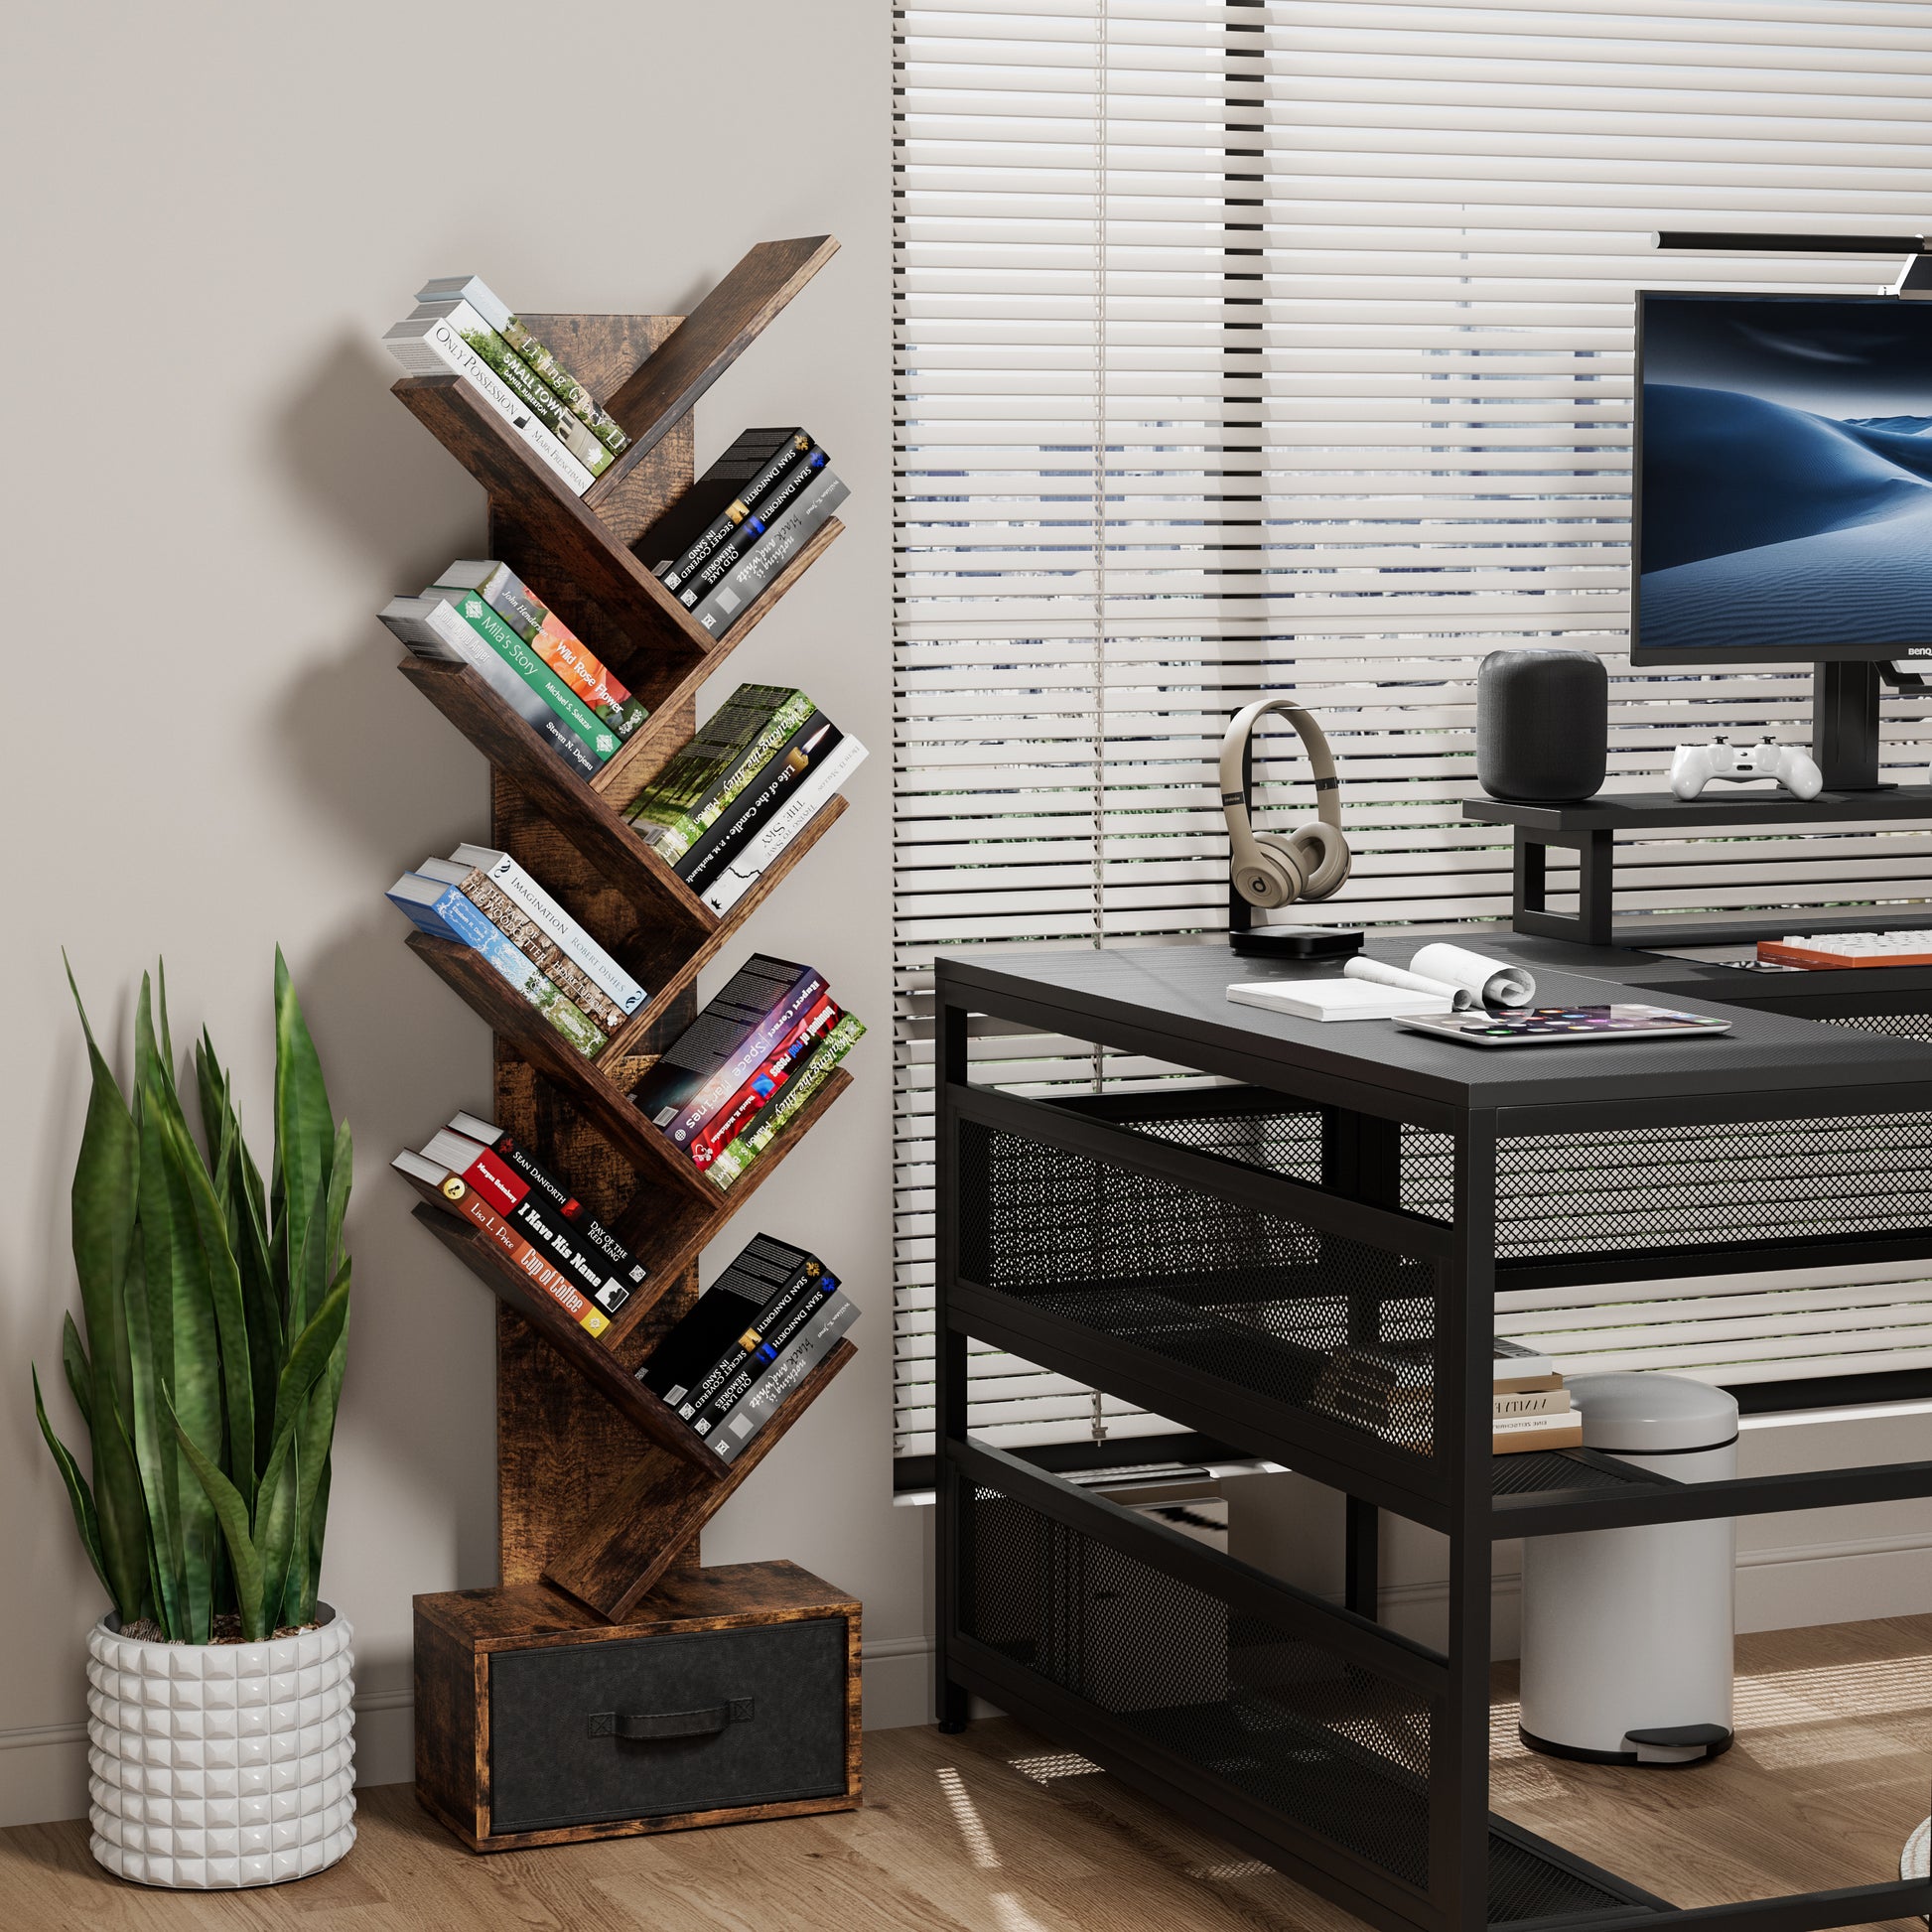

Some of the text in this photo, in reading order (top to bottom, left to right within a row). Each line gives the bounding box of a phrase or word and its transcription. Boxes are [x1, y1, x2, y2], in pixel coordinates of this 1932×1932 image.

[433, 325, 469, 361] ONLY
[462, 355, 521, 415] POSSESSION
[500, 351, 567, 420] SMALL TOWN
[502, 369, 523, 389] DANIEL
[518, 337, 609, 429] Living Glory
[531, 430, 554, 453] MARK
[743, 449, 796, 505] SEAN DANFORTH
[759, 465, 812, 522] SEAN DANFORTH
[679, 520, 734, 579] SECRET COVERED
[686, 529, 716, 560] IN SAND
[699, 542, 735, 580] MEMORIES
[706, 549, 740, 585] OLD LAKE
[734, 513, 803, 586] black and white
[755, 531, 796, 580] nothing is
[500, 588, 550, 638] John Henderson
[467, 639, 492, 665] Anger
[481, 616, 540, 678] Mila's Story
[1908, 647, 1932, 656] BenQ
[554, 641, 625, 716] Wild Rose Flower
[544, 681, 593, 731] Michael S. Salazar
[545, 721, 568, 744] Steven
[564, 740, 575, 752] N.
[719, 709, 799, 795] Walking the Alley
[728, 763, 795, 837] Life of the Candle
[759, 797, 805, 851] THE SKY
[662, 832, 688, 860] Bwn
[684, 852, 714, 884] Burkhardt
[466, 882, 548, 964] THE WOODCUTTER
[485, 887, 505, 906] THE
[523, 924, 539, 940] OF
[509, 876, 569, 935] IMAGINATION
[552, 960, 579, 987] HENRY
[570, 936, 600, 966] ROBERT
[765, 978, 820, 1038] Rupert Cornet
[729, 1038, 766, 1078] Space
[786, 1039, 805, 1058] red
[798, 1032, 812, 1045] of
[767, 1052, 791, 1077] roses
[770, 1033, 848, 1118] Walking the Alley
[511, 1151, 567, 1204] SEAN DANFORTH
[715, 1154, 741, 1182] Bwn
[470, 1202, 518, 1250] Lisa L. Price
[516, 1202, 605, 1288] I Have His Name
[587, 1229, 621, 1262] RED KING
[589, 1221, 628, 1259] DAY OF THE
[516, 1247, 587, 1313] Cup of Coffee
[756, 1276, 808, 1333] SEAN DANFORTH
[771, 1290, 823, 1348] SEAN DANFORTH
[693, 1349, 747, 1409] SECRET COVERED
[700, 1358, 729, 1390] IN SAND
[713, 1370, 748, 1408] MEMORIES
[720, 1376, 752, 1412] OLD LAKE
[747, 1337, 815, 1412] black and white
[766, 1356, 808, 1406] nothing is
